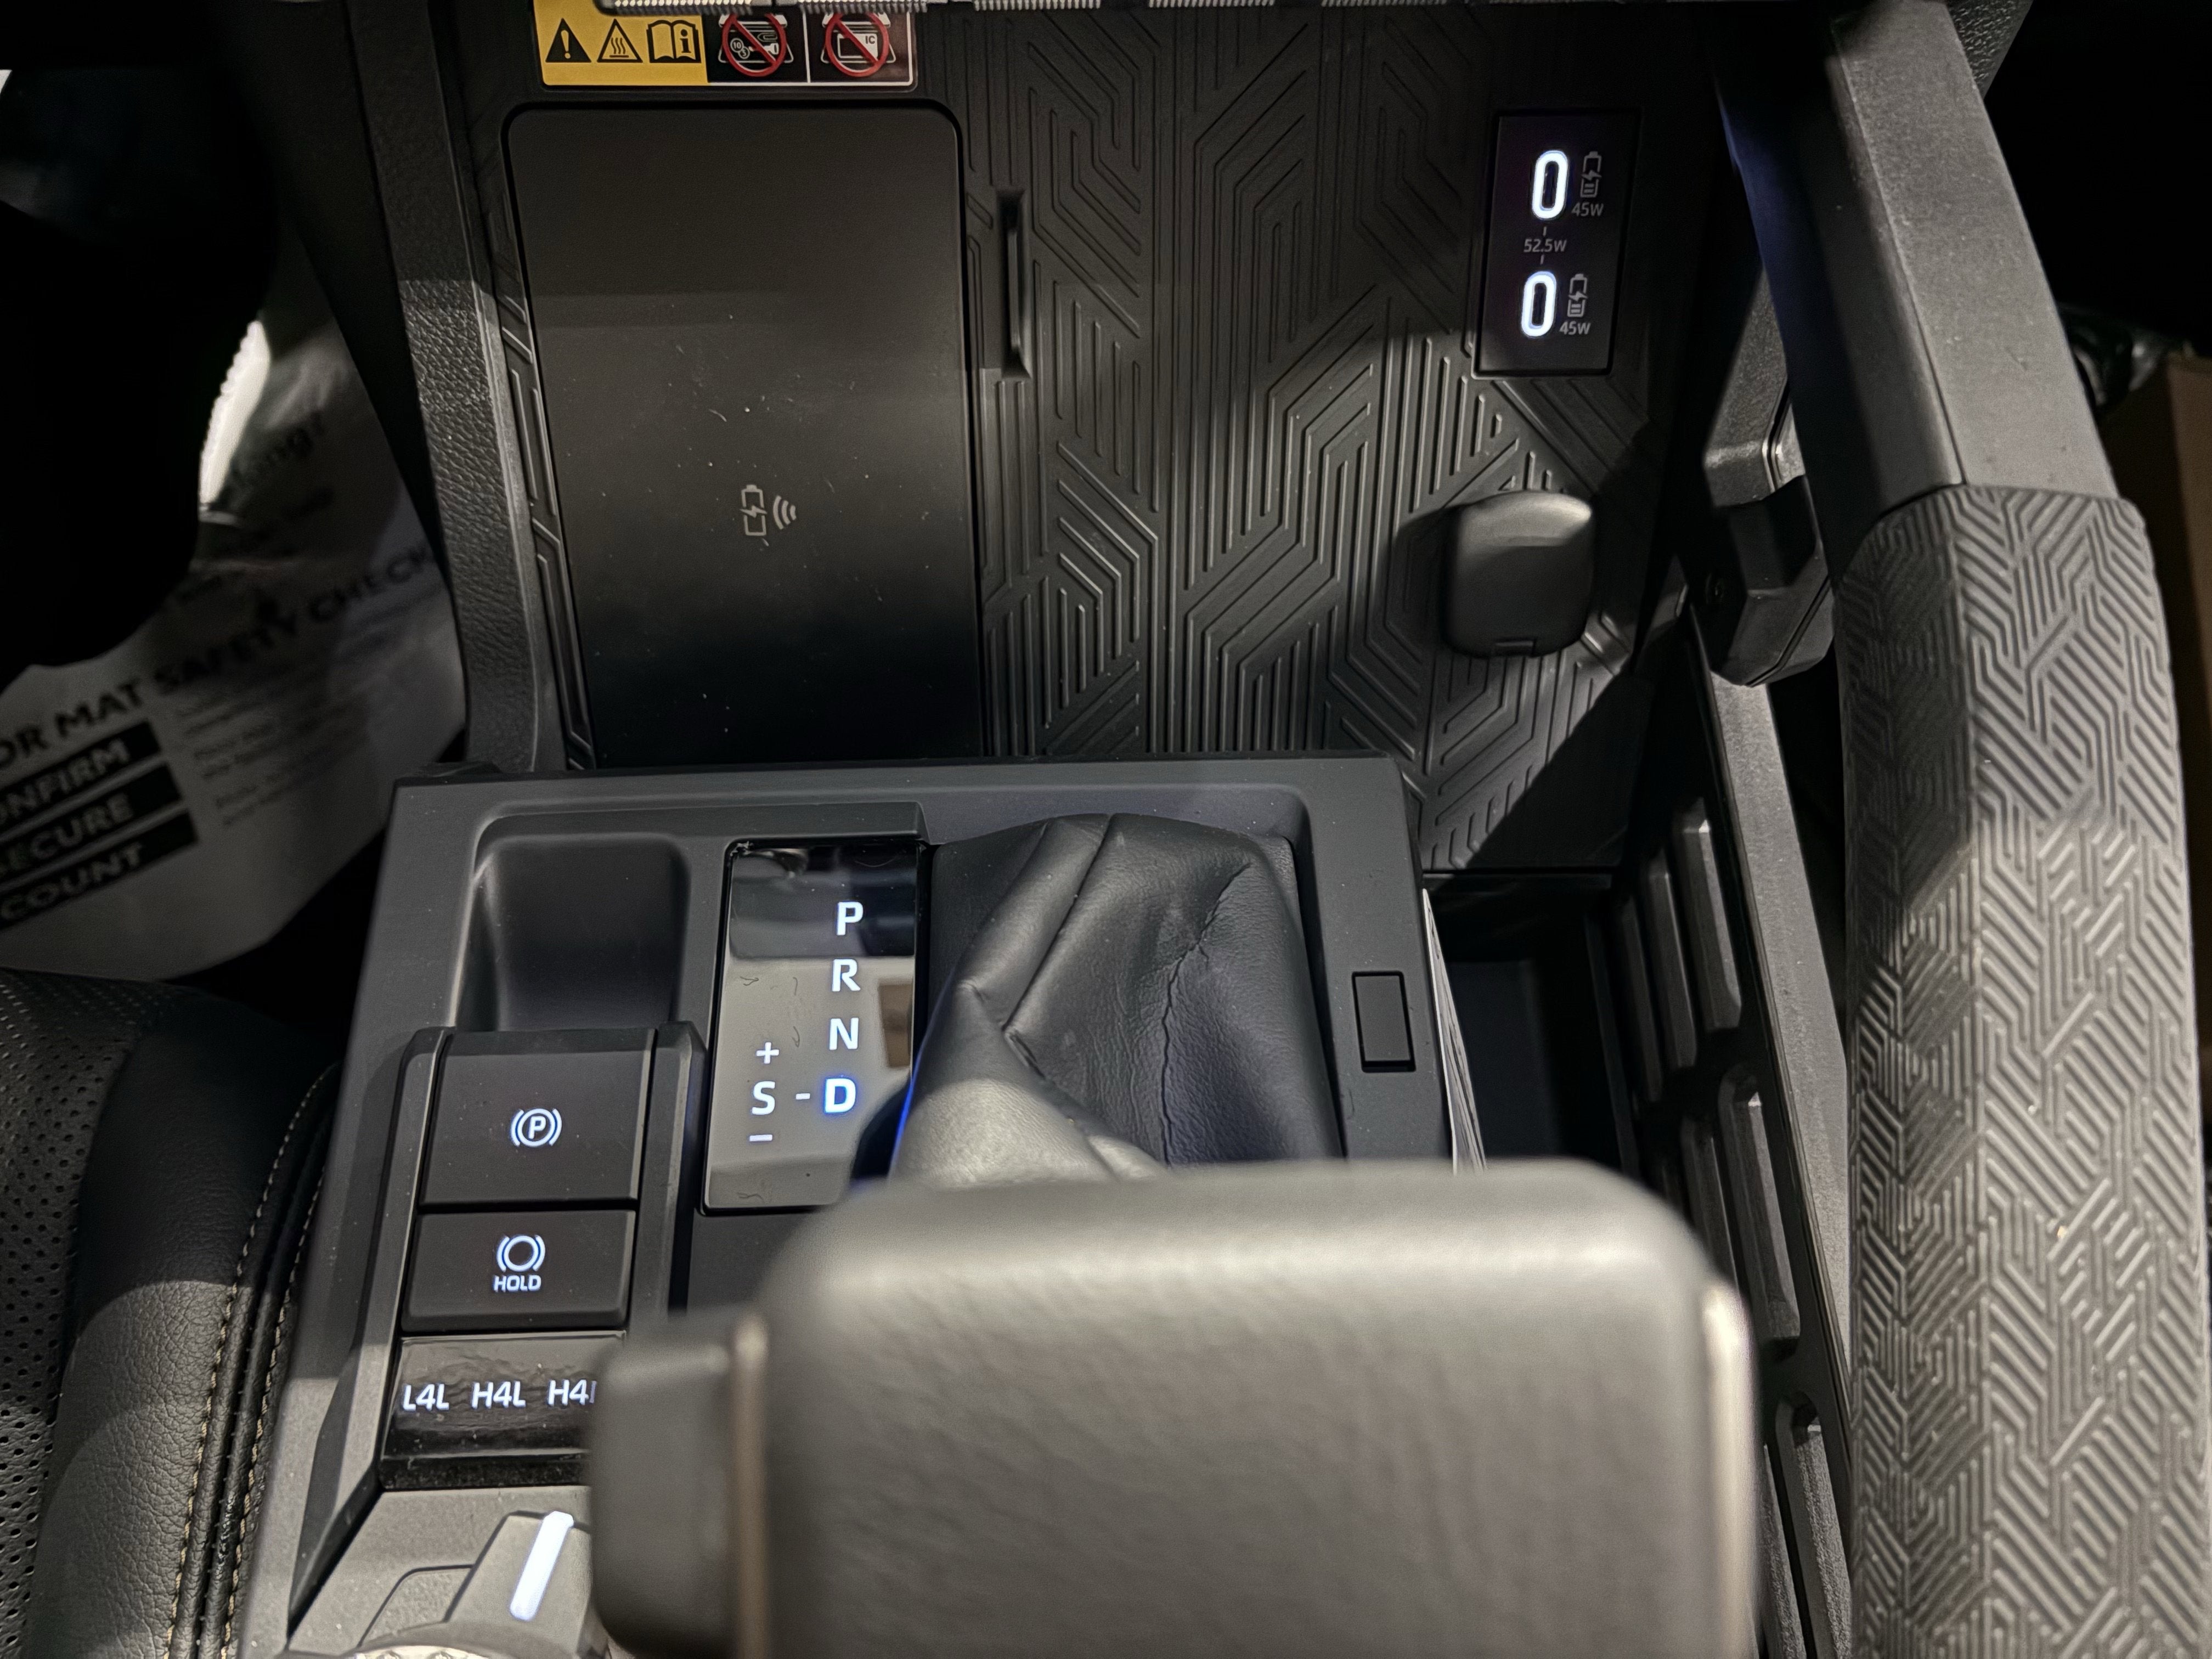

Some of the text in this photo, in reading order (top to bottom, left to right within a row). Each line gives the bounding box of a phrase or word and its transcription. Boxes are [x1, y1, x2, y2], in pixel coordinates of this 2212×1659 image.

[865, 35, 876, 44] IC
[1532, 149, 1604, 219] 0 45W
[1523, 238, 1567, 252] 52.5W
[1521, 270, 1591, 337] 0 45W
[55, 678, 143, 737] MAT
[836, 901, 864, 936] P
[832, 958, 861, 992] R
[829, 1017, 859, 1050] N
[751, 1081, 776, 1115] S
[823, 1077, 856, 1114] D
[494, 1275, 541, 1291] HOLD
[403, 1383, 449, 1411] L4L
[472, 1380, 526, 1409] H4L
